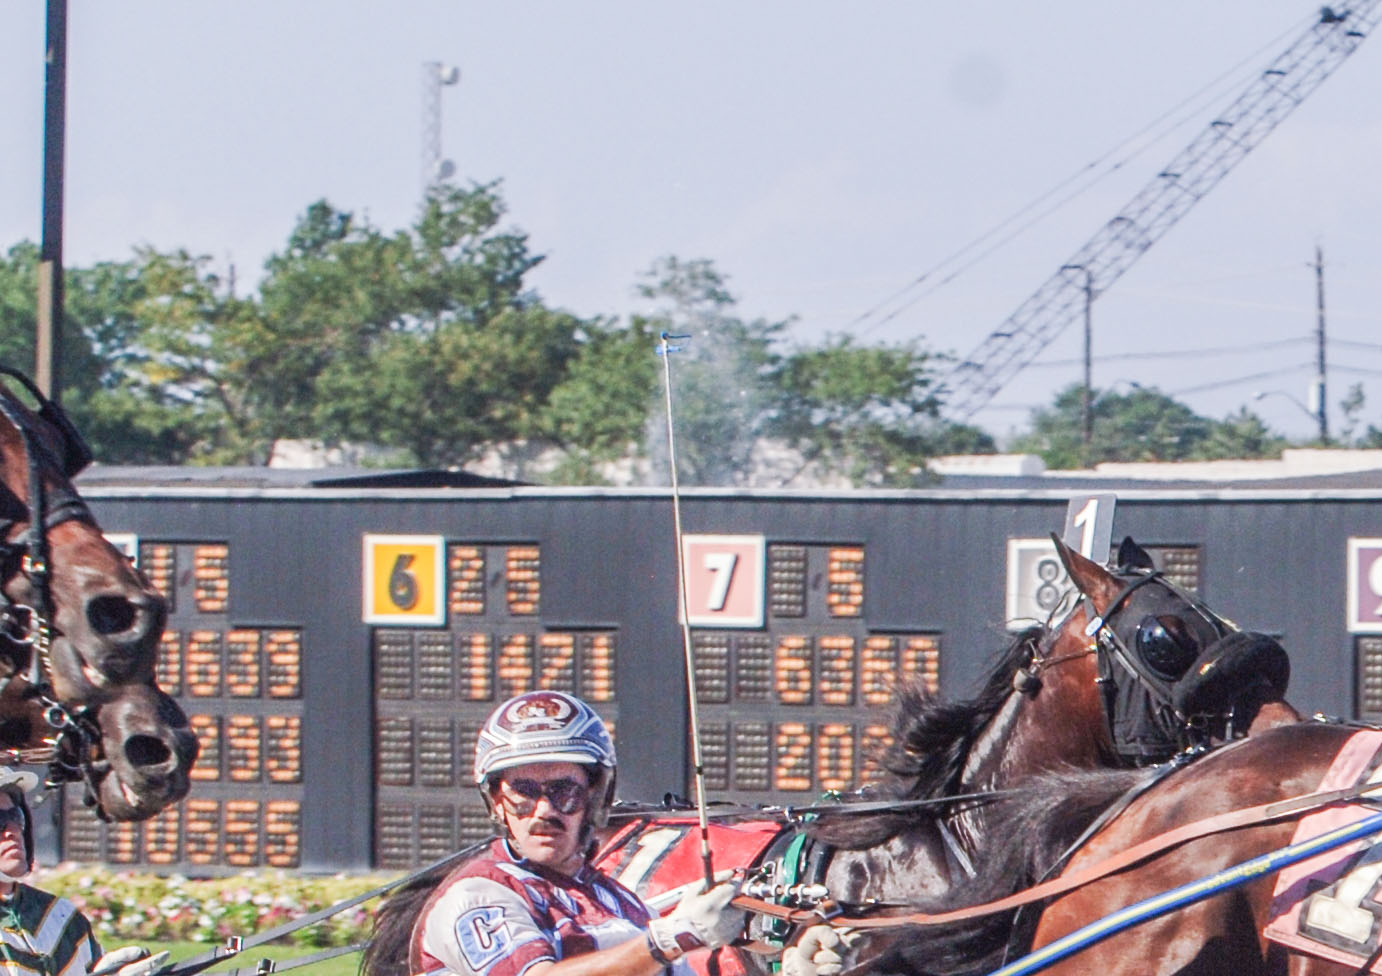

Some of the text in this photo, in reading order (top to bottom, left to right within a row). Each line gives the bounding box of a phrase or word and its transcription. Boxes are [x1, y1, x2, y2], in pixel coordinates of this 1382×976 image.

[1073, 498, 1099, 559] 1
[388, 553, 419, 611] 6
[703, 553, 738, 612] 7
[1034, 555, 1066, 614] 8
[617, 827, 682, 893] 1
[454, 905, 512, 972] C
